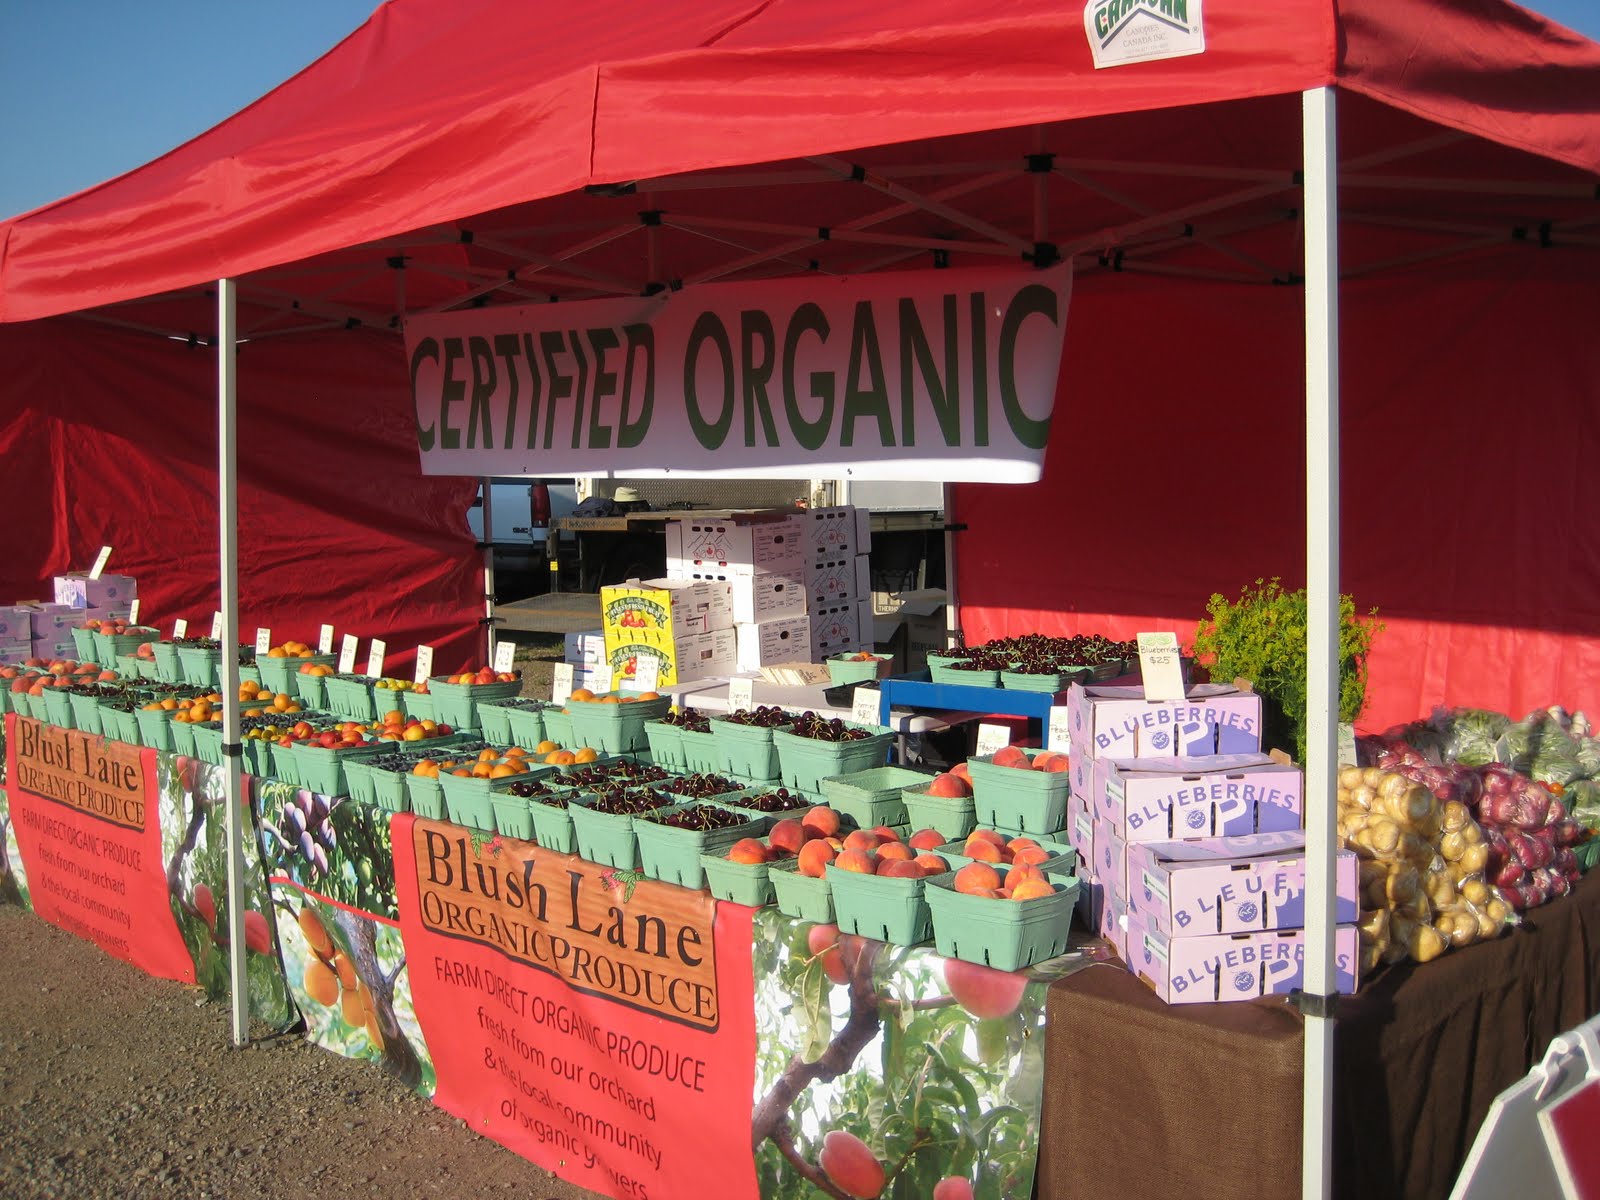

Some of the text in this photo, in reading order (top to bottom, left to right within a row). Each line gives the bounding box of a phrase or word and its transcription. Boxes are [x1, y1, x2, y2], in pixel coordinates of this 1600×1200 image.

[1122, 36, 1153, 48] CANADA
[1125, 24, 1160, 36] CANOPIES
[409, 284, 1060, 452] CERTIFIED ORGANIC
[1140, 645, 1178, 654] Blueberries
[1149, 656, 1171, 665] $25
[20, 719, 138, 791] Blush Lane
[1095, 707, 1255, 749] BLUEBERRIES
[17, 762, 145, 826] ORGANIC PRODUCE
[1127, 783, 1296, 830] BLUEBERRIES
[22, 808, 41, 830] FARM
[42, 815, 66, 841] DIRECT
[102, 840, 142, 872] PRODUCE
[56, 852, 77, 875] from
[91, 872, 126, 896] orchard
[423, 828, 704, 968] Blush Lane
[47, 877, 61, 896] the
[61, 884, 80, 905] local
[81, 895, 132, 930] community
[423, 890, 718, 1021] ORGANIC PRODUCE
[434, 956, 706, 1093] FARM DIRECT ORGANIC PRODUCE
[477, 1006, 657, 1122] fresh from our orchard
[484, 1046, 662, 1171] & the local community
[520, 1111, 580, 1156] organic
